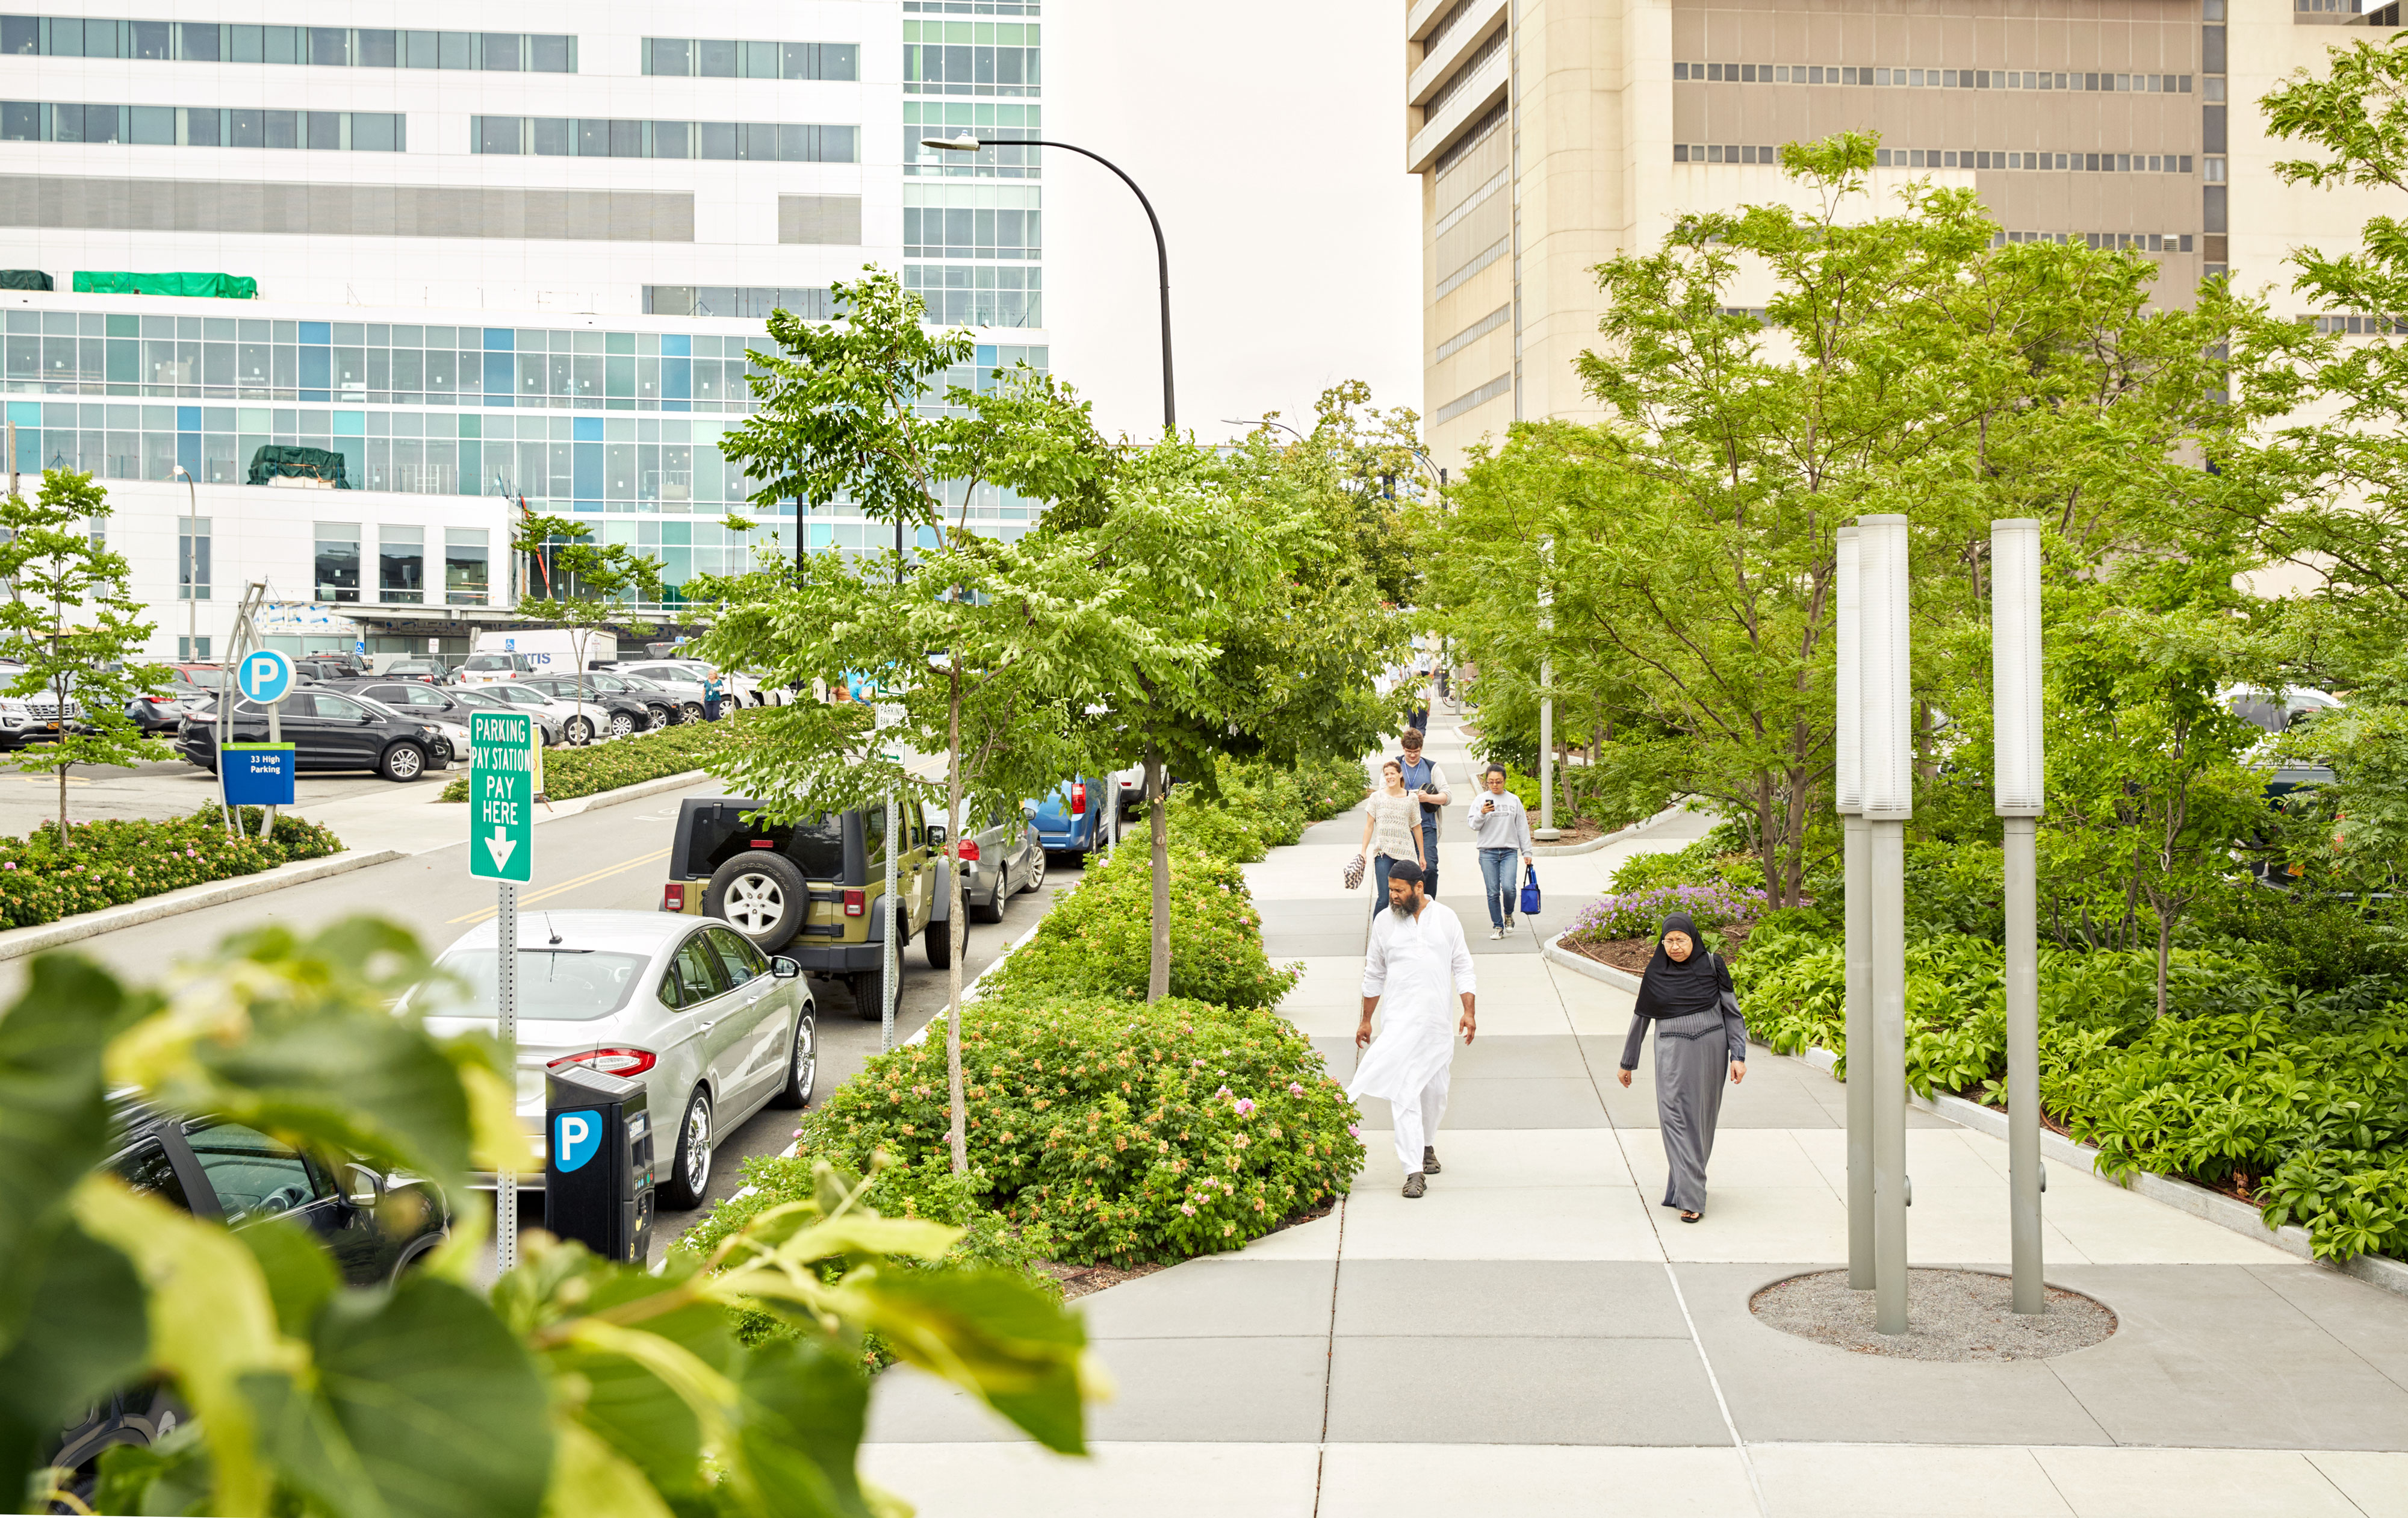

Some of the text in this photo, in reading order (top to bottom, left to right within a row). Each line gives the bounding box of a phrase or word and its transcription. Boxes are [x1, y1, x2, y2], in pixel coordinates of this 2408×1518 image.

[252, 658, 279, 695] P
[880, 705, 903, 716] PARKING
[880, 716, 890, 726] 8AM
[476, 718, 526, 743] PARKING
[250, 765, 281, 774] Parking
[262, 755, 281, 764] High
[471, 747, 531, 772] PAY STATION
[486, 776, 515, 799] PAY
[483, 800, 518, 825] HERE
[732, 863, 790, 891] GOODYEAR
[562, 1117, 589, 1160] P
